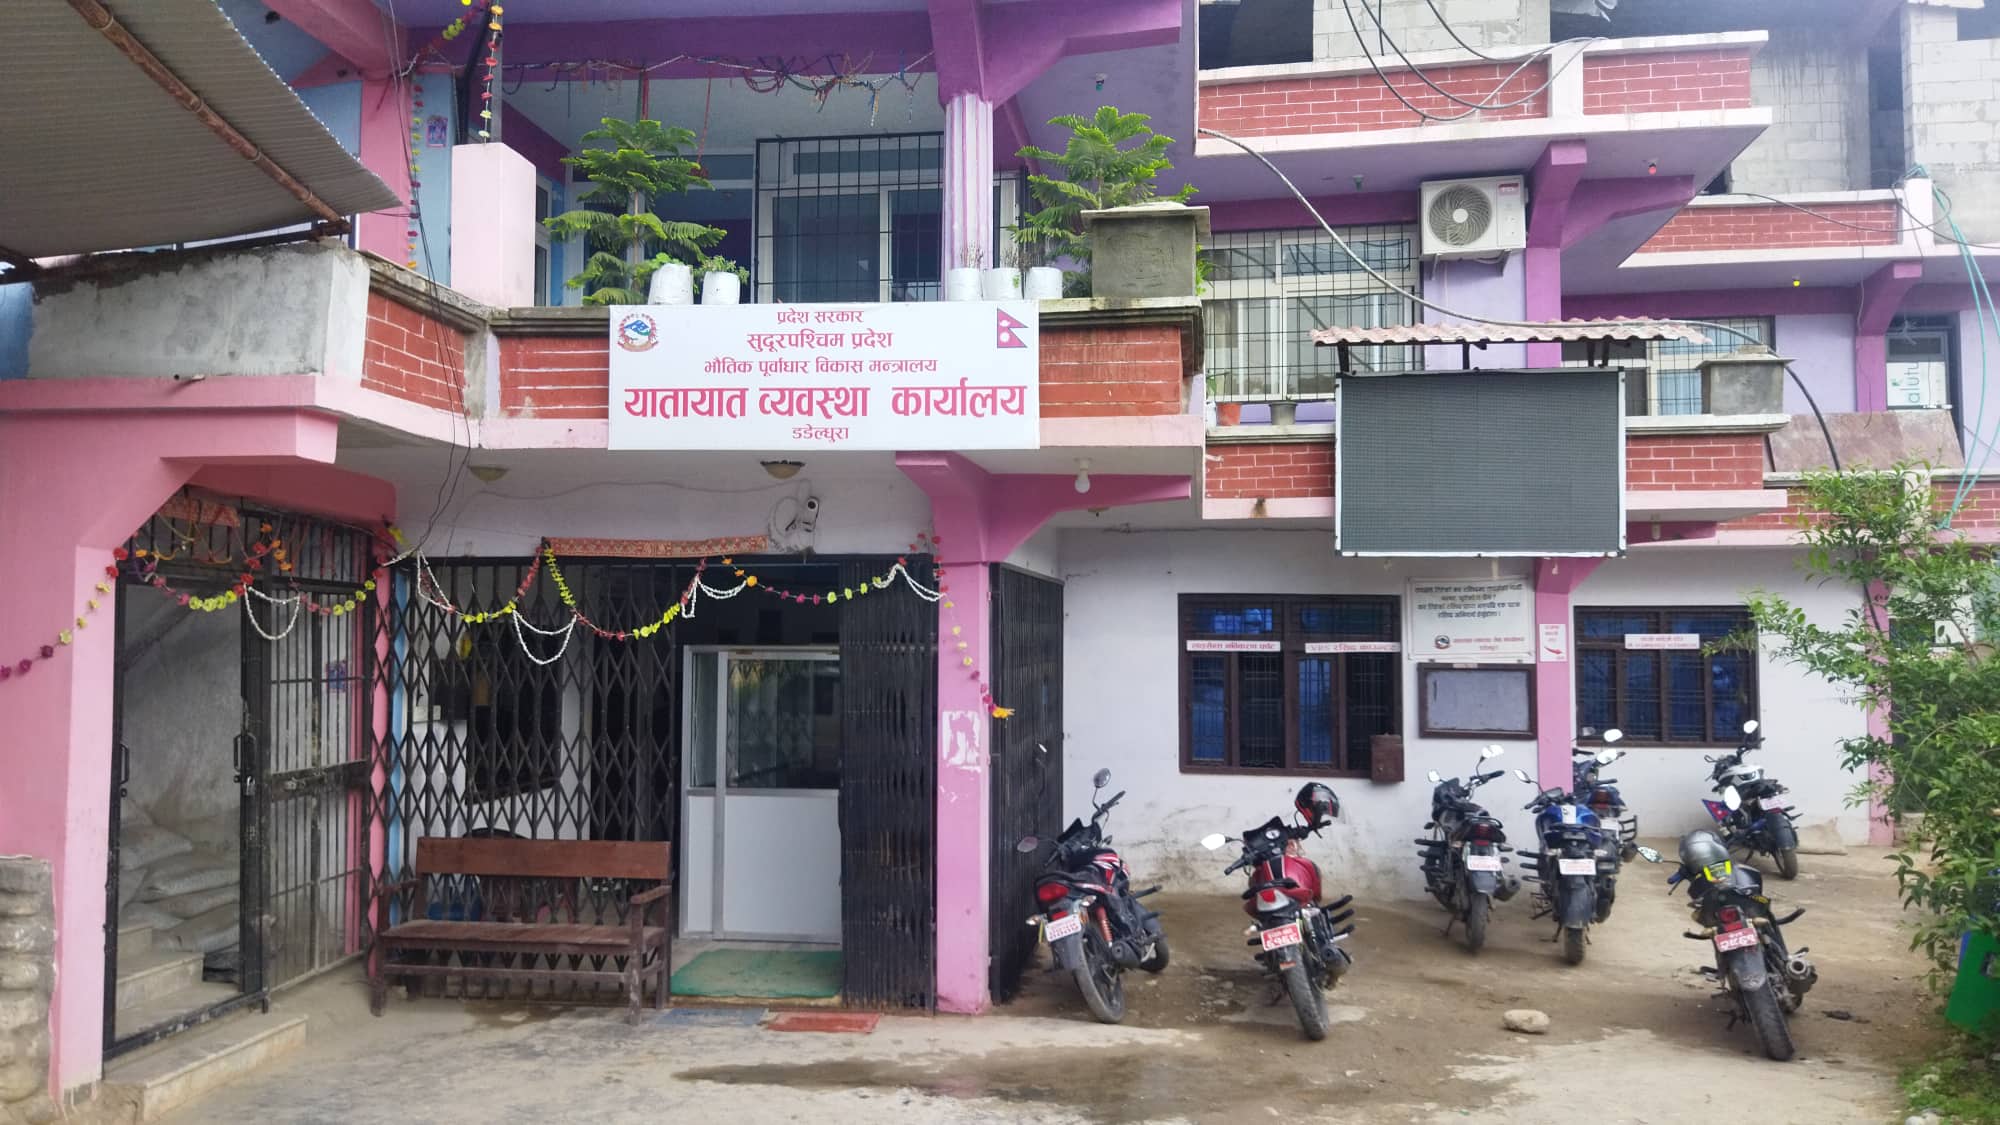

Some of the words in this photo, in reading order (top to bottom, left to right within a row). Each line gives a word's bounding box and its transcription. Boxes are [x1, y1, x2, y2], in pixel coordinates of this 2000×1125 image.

[777, 307, 809, 325] प्रदेश
[814, 310, 865, 324] सरकार
[746, 328, 845, 353] सुदूरपश्चिम
[851, 327, 892, 350] प्रदेश
[704, 356, 753, 374] भौतिक
[758, 357, 810, 377] पूर्वाधार
[815, 356, 863, 374] विकास
[868, 359, 937, 373] मन्त्रालय
[623, 387, 750, 420] यातायात
[758, 386, 871, 420] व्यवस्था
[891, 376, 1028, 418] कार्यालय
[792, 423, 849, 443] डडेल्धुरा
